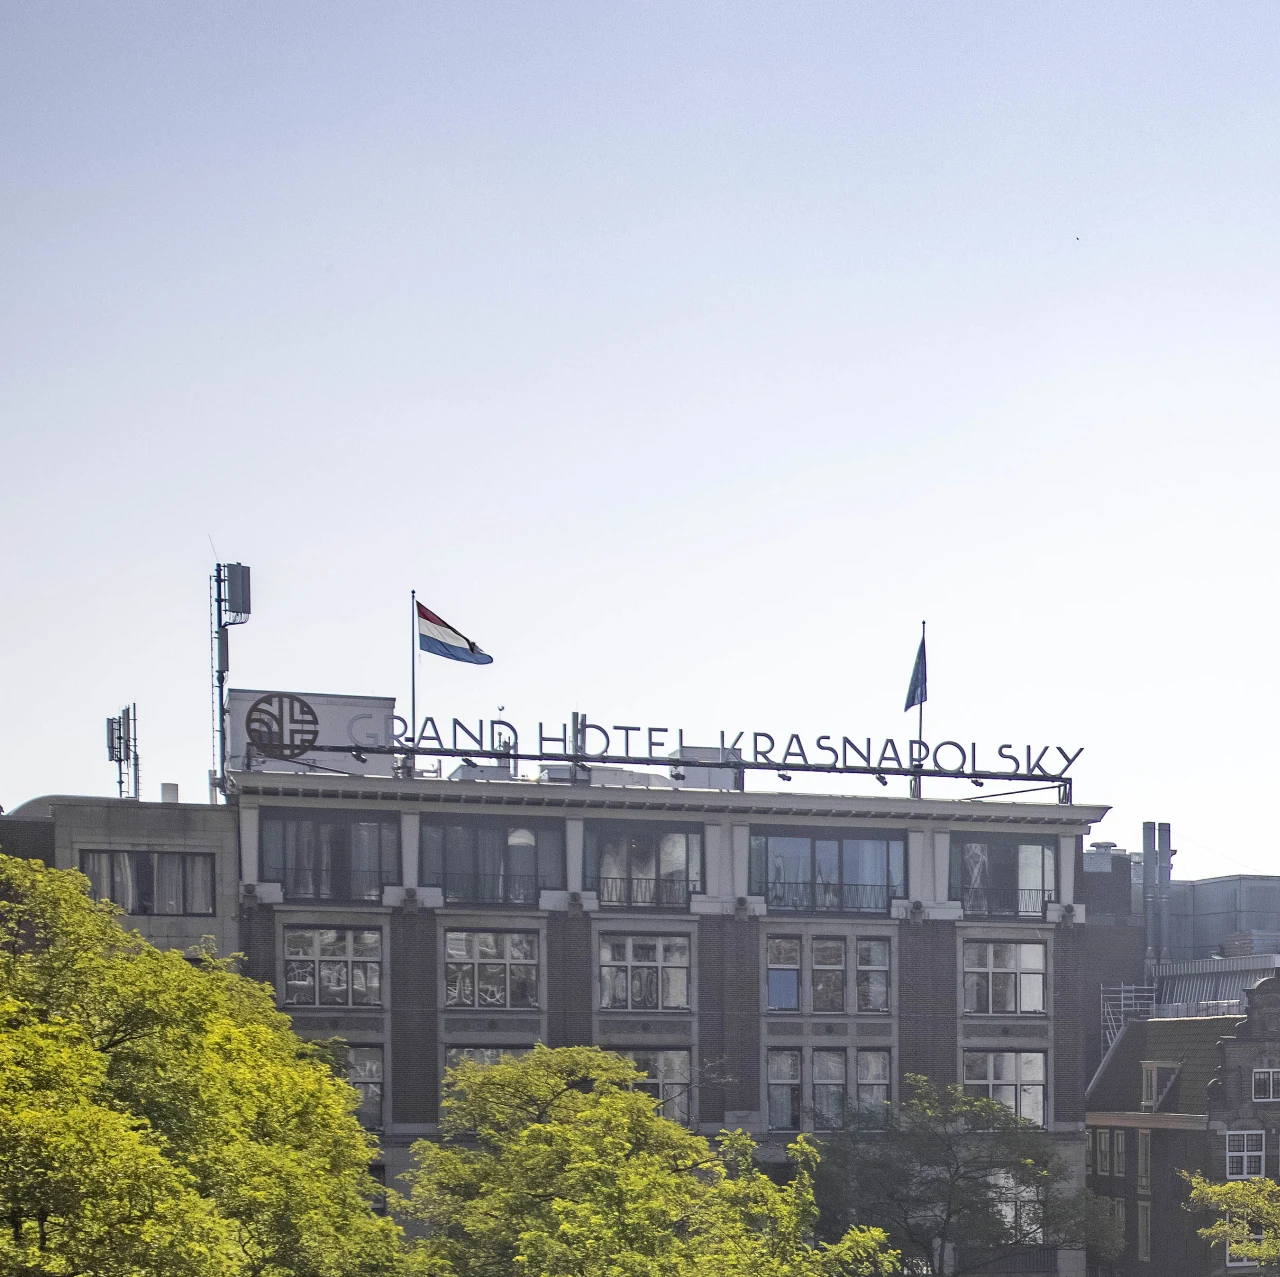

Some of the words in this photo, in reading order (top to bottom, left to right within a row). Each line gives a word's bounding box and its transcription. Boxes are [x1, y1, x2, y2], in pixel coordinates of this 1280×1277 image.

[347, 713, 518, 753] GRAND
[538, 722, 698, 764] HOTEL
[719, 729, 1085, 777] KRASNAPOLSKY
